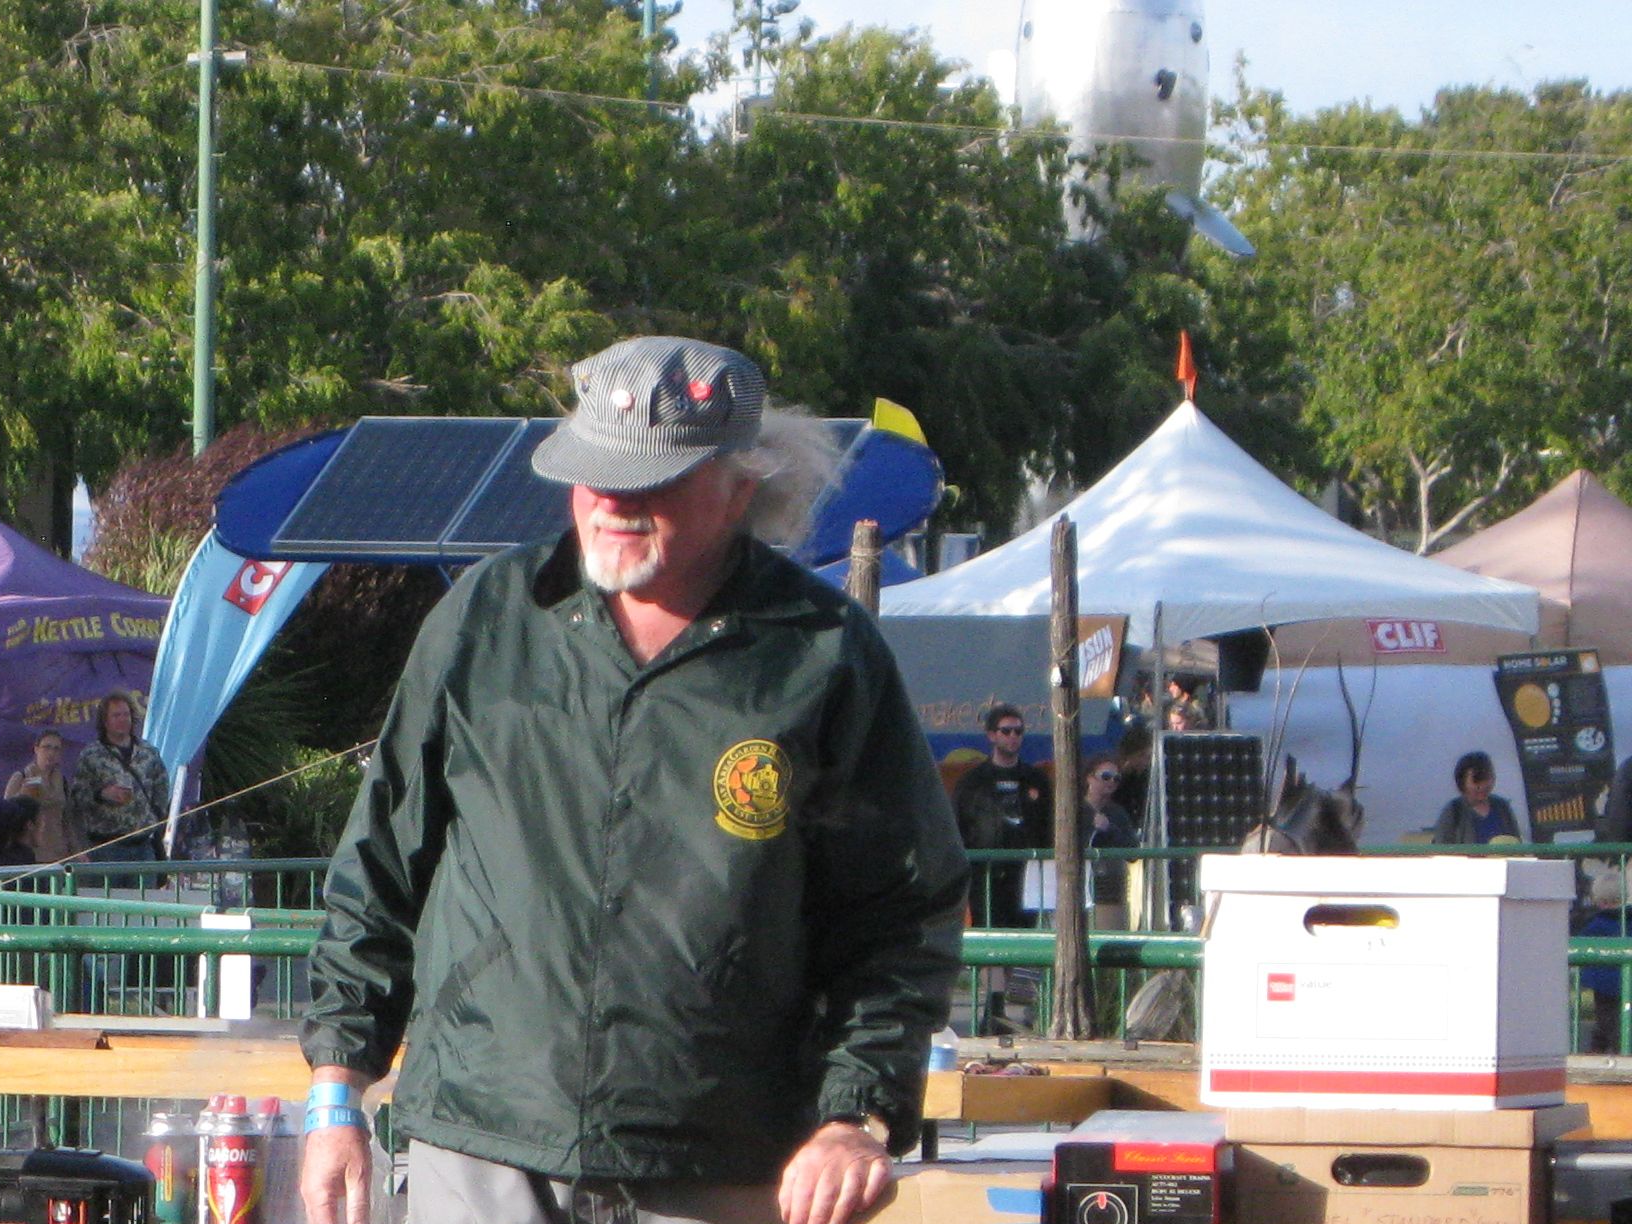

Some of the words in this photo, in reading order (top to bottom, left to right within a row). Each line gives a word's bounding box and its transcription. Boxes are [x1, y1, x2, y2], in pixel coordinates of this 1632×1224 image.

[33, 616, 104, 643] KETTLE
[1375, 622, 1439, 649] CLIF
[1502, 658, 1533, 669] HOME
